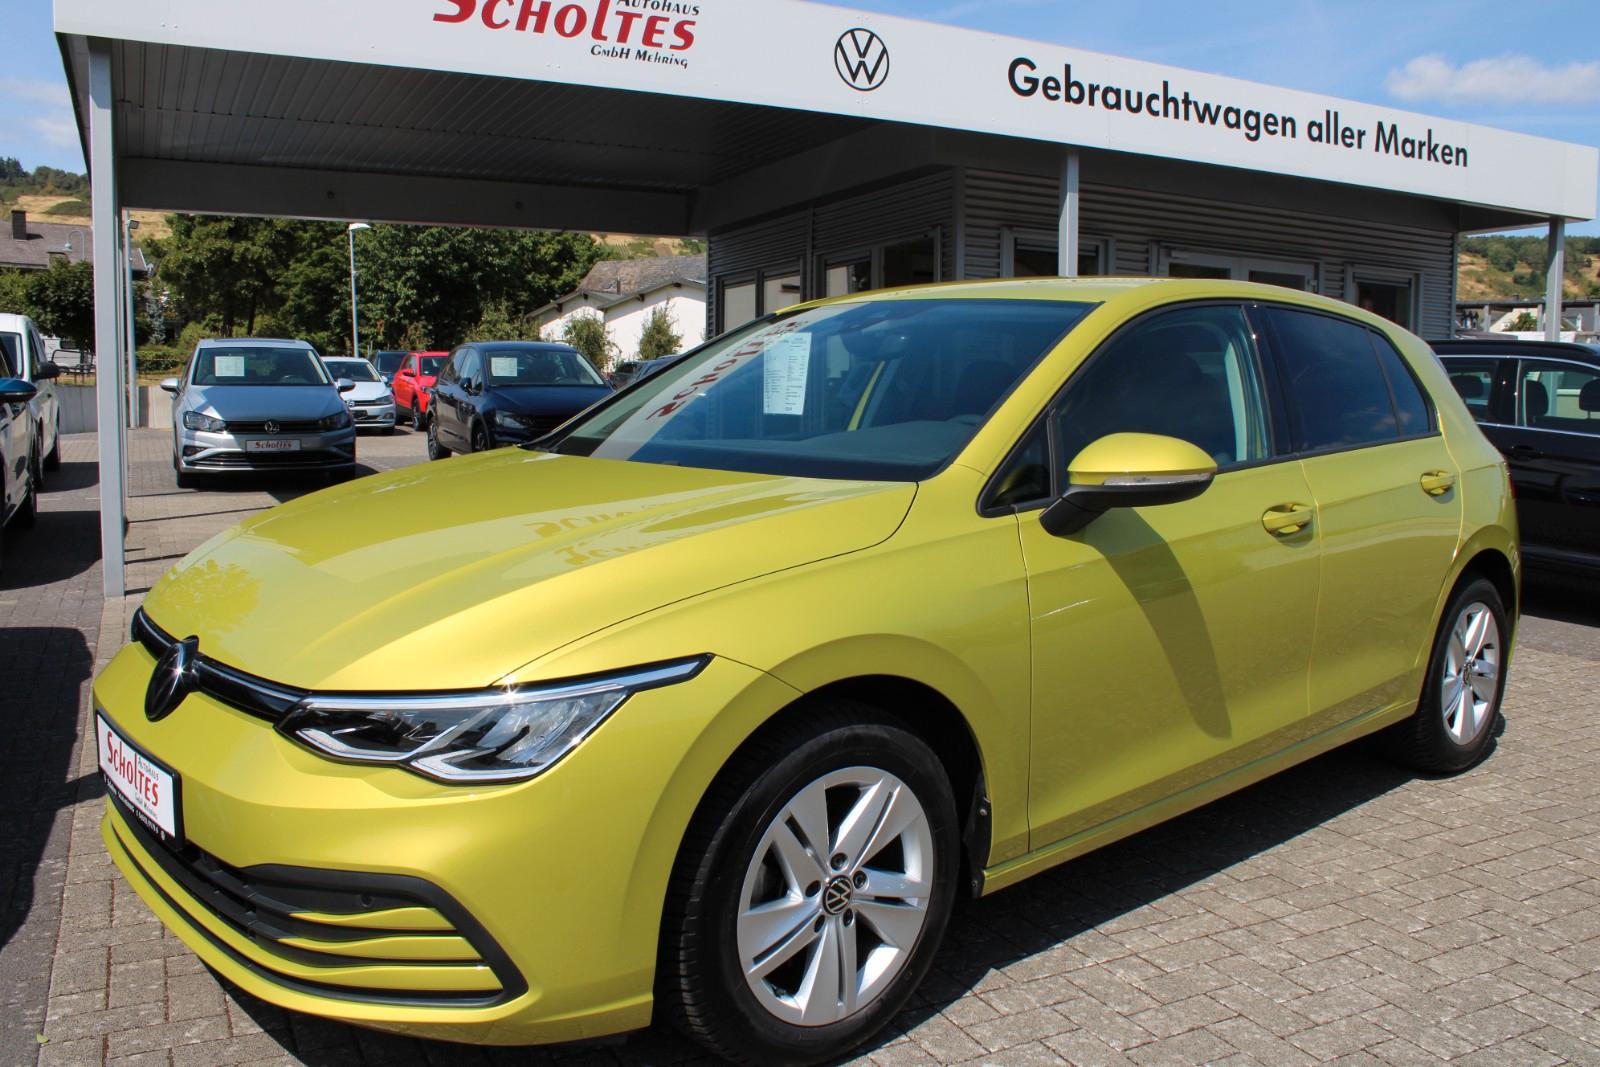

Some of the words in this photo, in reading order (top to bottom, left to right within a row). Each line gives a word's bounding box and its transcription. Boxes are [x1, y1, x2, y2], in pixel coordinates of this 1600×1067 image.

[1007, 57, 1297, 142] Gebrauchtwagen
[1307, 110, 1366, 151] aller
[1374, 121, 1468, 168] Marken
